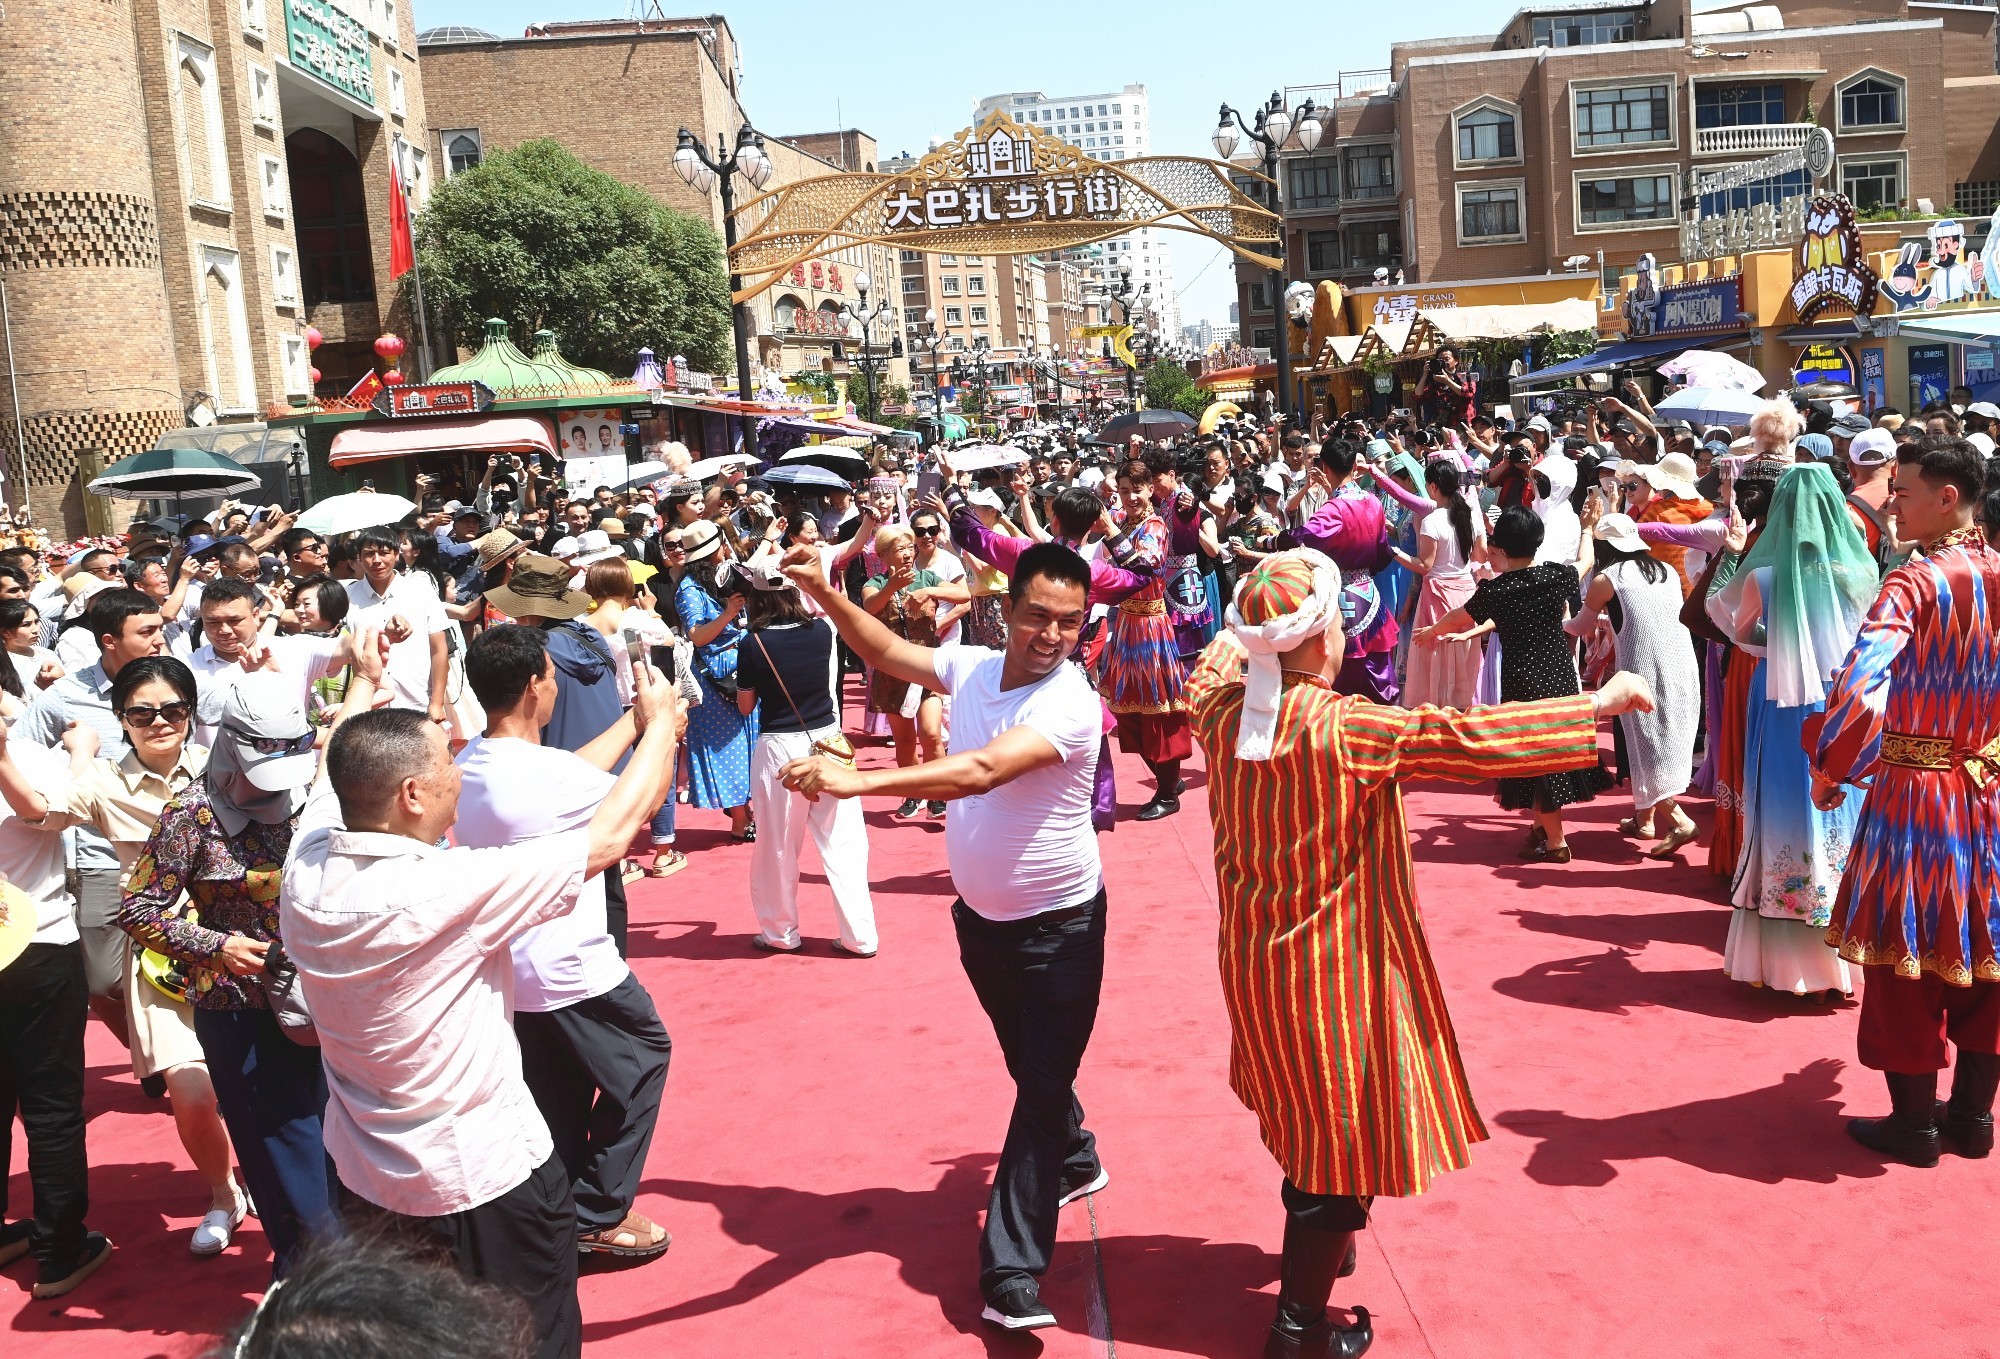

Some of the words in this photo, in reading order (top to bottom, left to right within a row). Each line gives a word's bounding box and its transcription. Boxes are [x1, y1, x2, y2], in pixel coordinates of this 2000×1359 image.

[292, 28, 373, 101] 二道桥清真寺
[886, 176, 1121, 228] 大巴扎步行街
[1422, 292, 1455, 302] GRAND
[1664, 294, 1723, 328] 阿凡提文创
[1791, 265, 1864, 312] 蜜酿卡瓦斯
